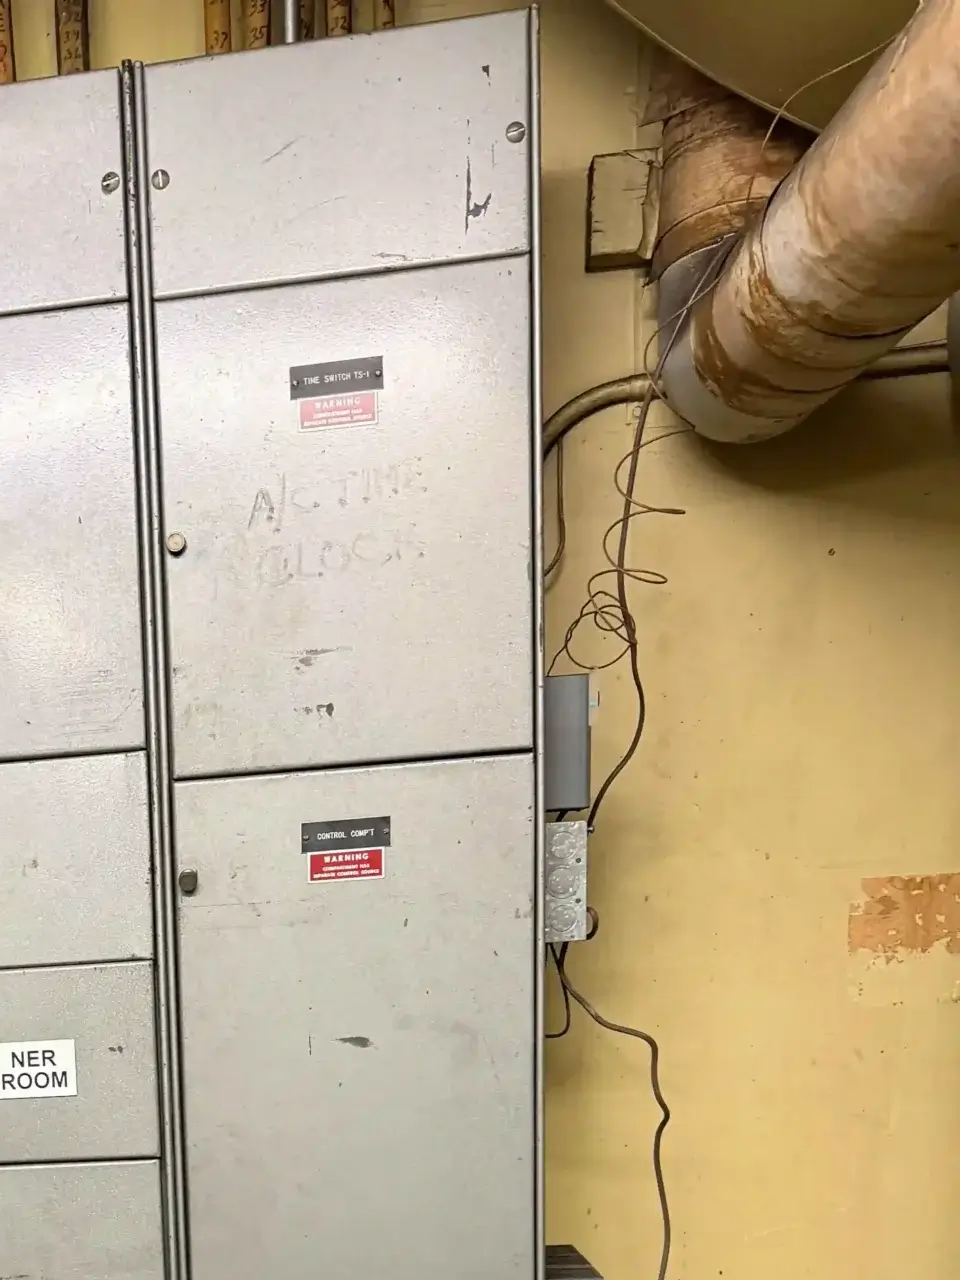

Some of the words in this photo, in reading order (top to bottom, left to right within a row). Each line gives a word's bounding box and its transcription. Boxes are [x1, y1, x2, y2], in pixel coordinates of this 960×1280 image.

[303, 376, 321, 386] TIME
[324, 372, 351, 383] SWITCH
[314, 396, 361, 410] WARNING
[316, 831, 347, 840] CONTROL
[323, 852, 369, 863] WARNING
[11, 1049, 56, 1069] NER
[1, 1070, 68, 1091] ROOM
